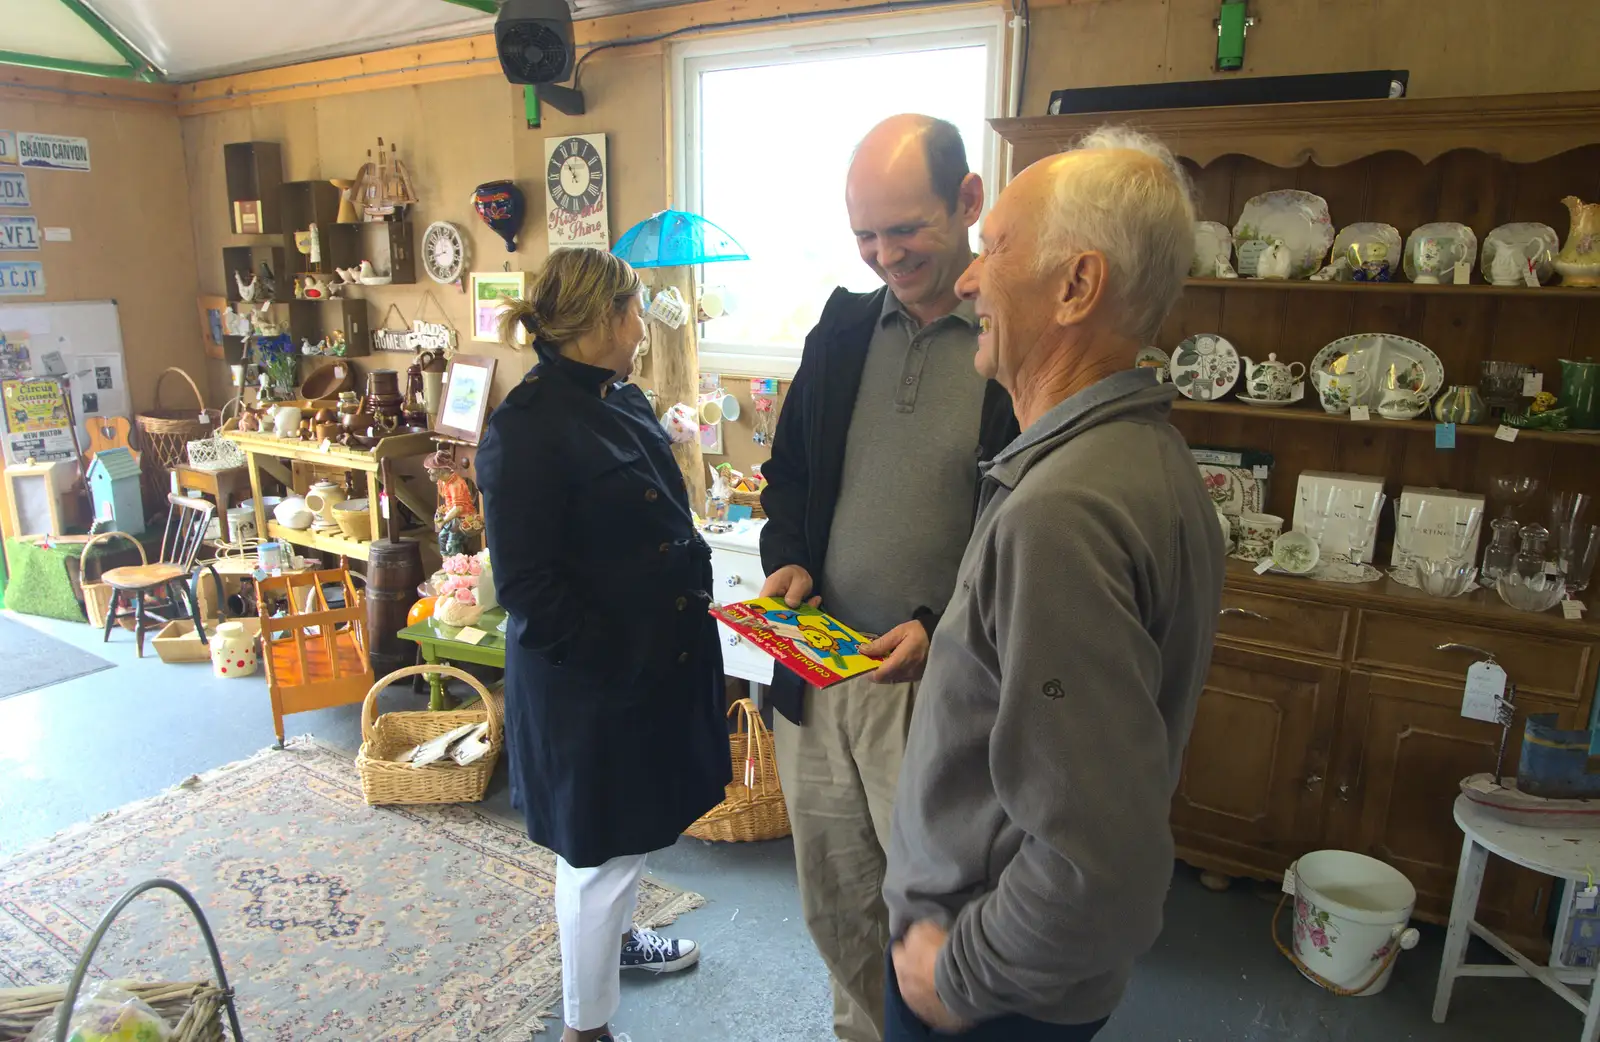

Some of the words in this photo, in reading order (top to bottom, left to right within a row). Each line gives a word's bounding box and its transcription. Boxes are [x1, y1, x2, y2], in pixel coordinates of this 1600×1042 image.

[20, 141, 51, 158] GRAND
[52, 143, 87, 162] CANYON
[548, 207, 579, 230] Rise
[581, 192, 603, 217] and
[568, 221, 601, 241] Shine
[10, 270, 36, 287] CJT
[374, 332, 400, 350] HOME
[20, 384, 53, 394] Circus
[39, 429, 62, 438] MILTON
